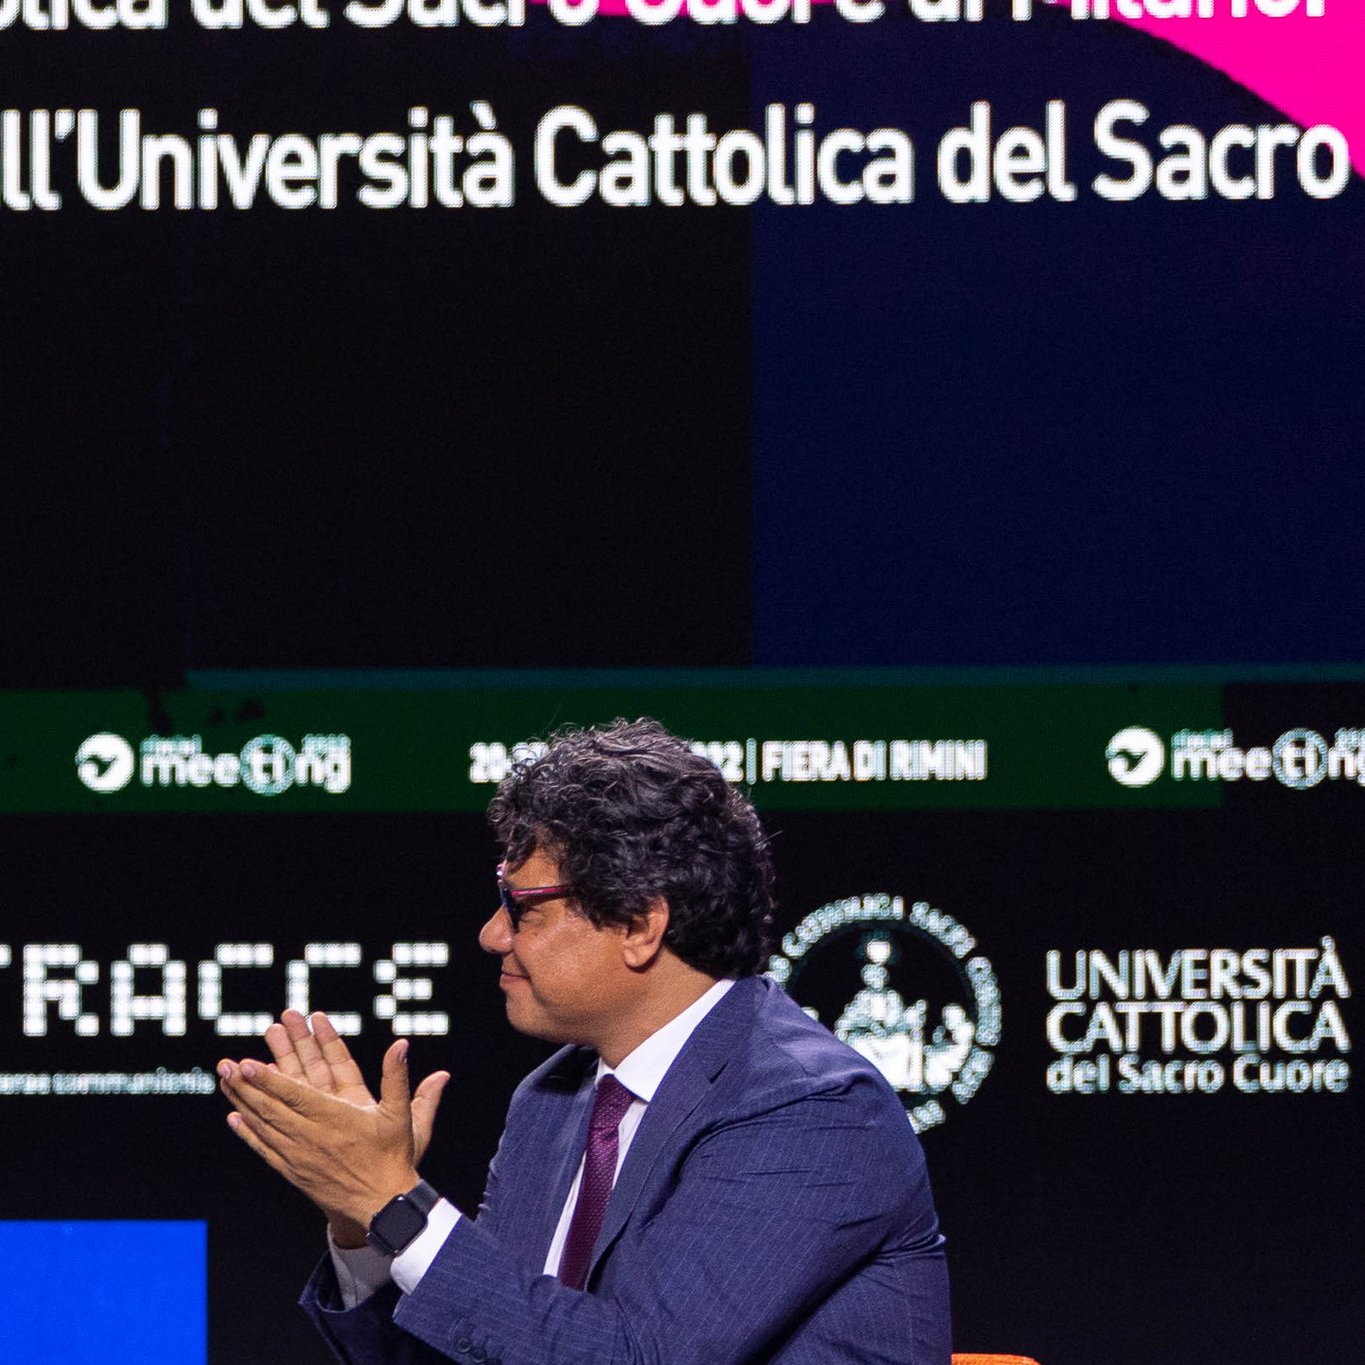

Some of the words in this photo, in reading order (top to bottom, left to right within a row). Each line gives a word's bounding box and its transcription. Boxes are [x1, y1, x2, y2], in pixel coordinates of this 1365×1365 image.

[534, 103, 915, 208] Cattolica
[937, 100, 1076, 204] del
[1093, 99, 1351, 202] Sacro
[139, 738, 352, 795] meeting
[761, 740, 851, 782] FIERA
[853, 740, 887, 781] DI
[1171, 736, 1365, 789] meetin
[1046, 934, 1352, 1000] UNIVERSITÀ
[1045, 999, 1352, 1054] CATTOLICA
[1046, 1053, 1110, 1095] del
[1117, 1053, 1225, 1095] Sacro
[1232, 1053, 1351, 1094] Cuore
